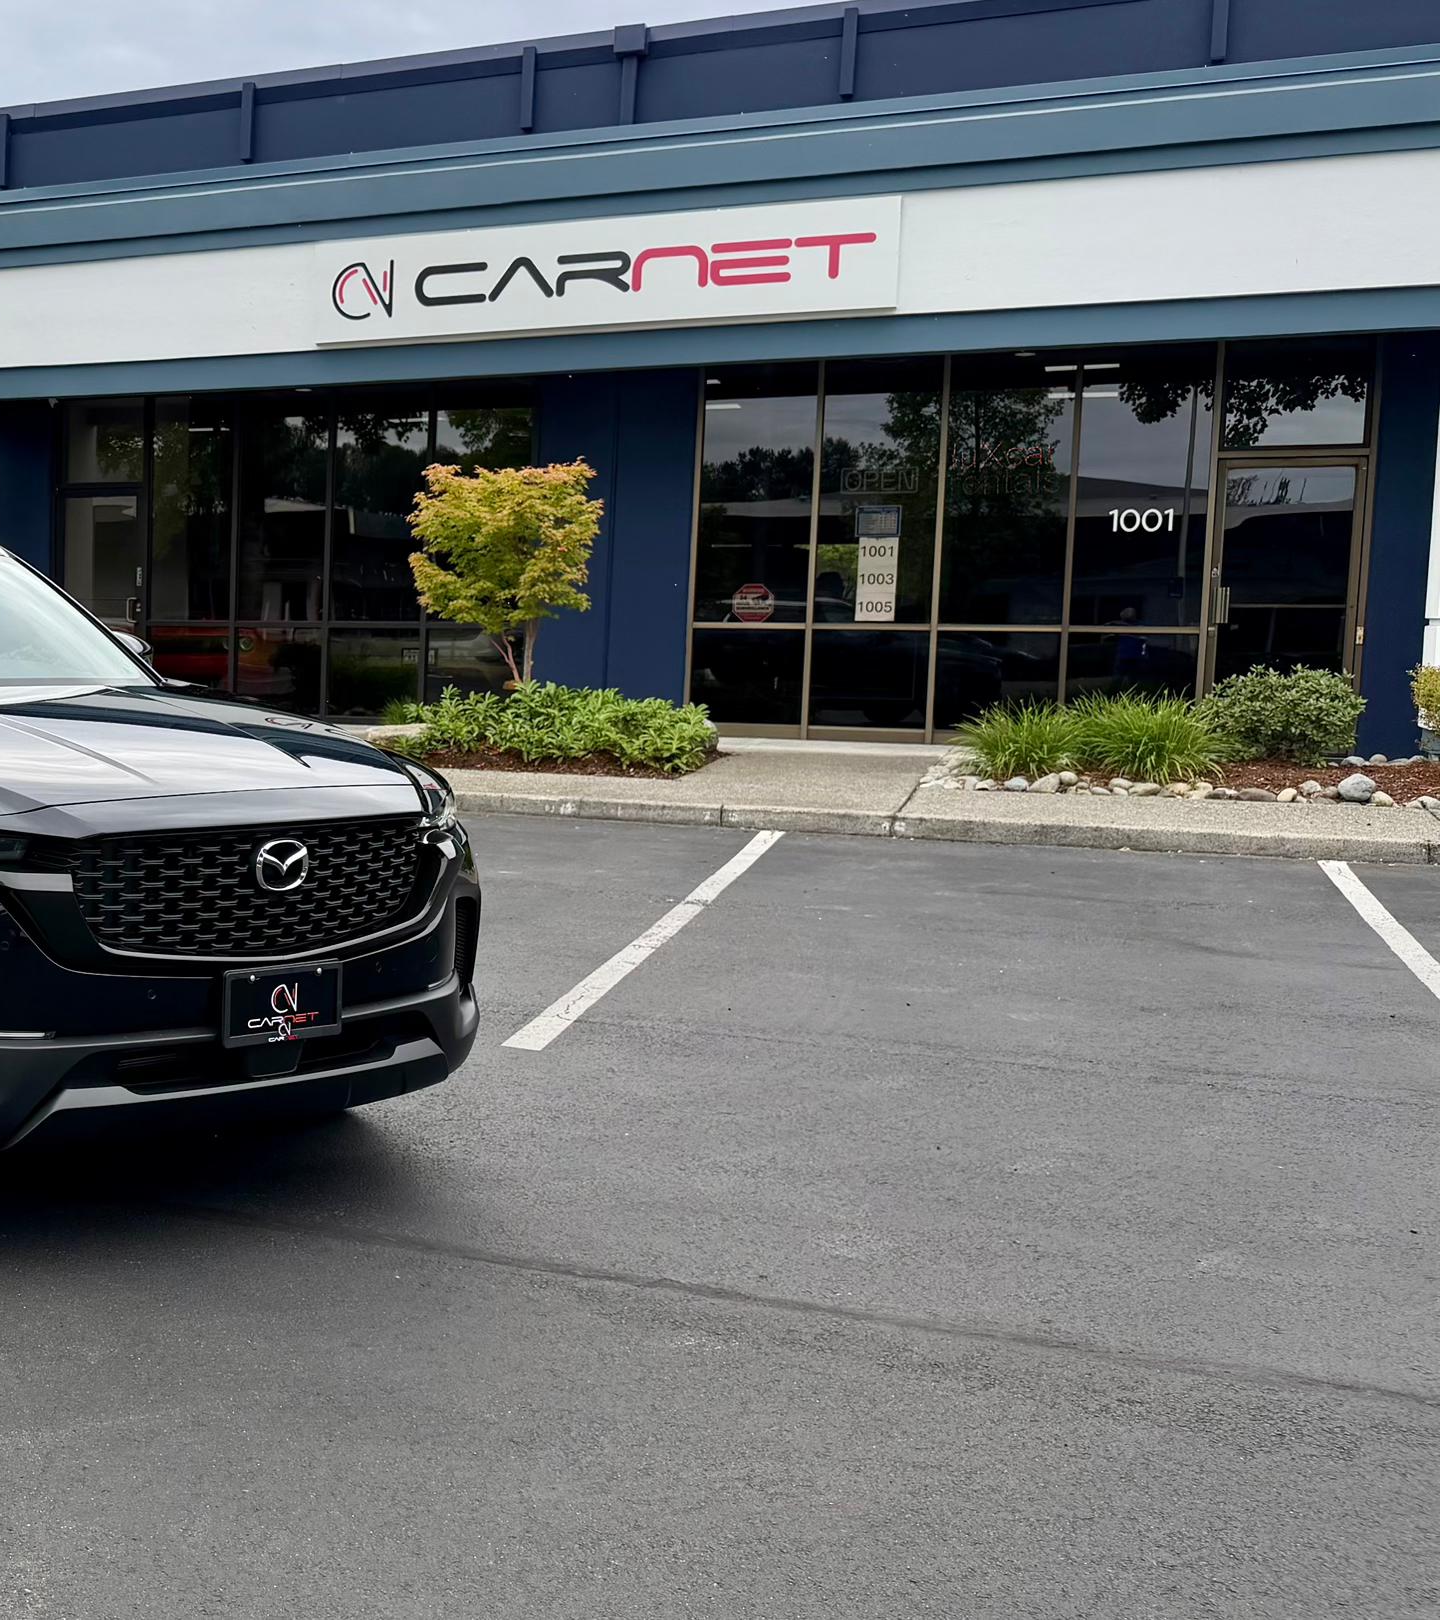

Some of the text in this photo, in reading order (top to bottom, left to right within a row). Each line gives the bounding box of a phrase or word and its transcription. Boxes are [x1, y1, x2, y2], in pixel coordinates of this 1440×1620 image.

[415, 232, 876, 306] CARNET
[844, 467, 917, 491] OPEN
[1109, 507, 1174, 533] 1001
[860, 545, 894, 557] 1001
[859, 573, 894, 585] 1003
[857, 601, 893, 613] 1005
[248, 1011, 320, 1029] CARNET
[268, 1034, 299, 1043] CARET
